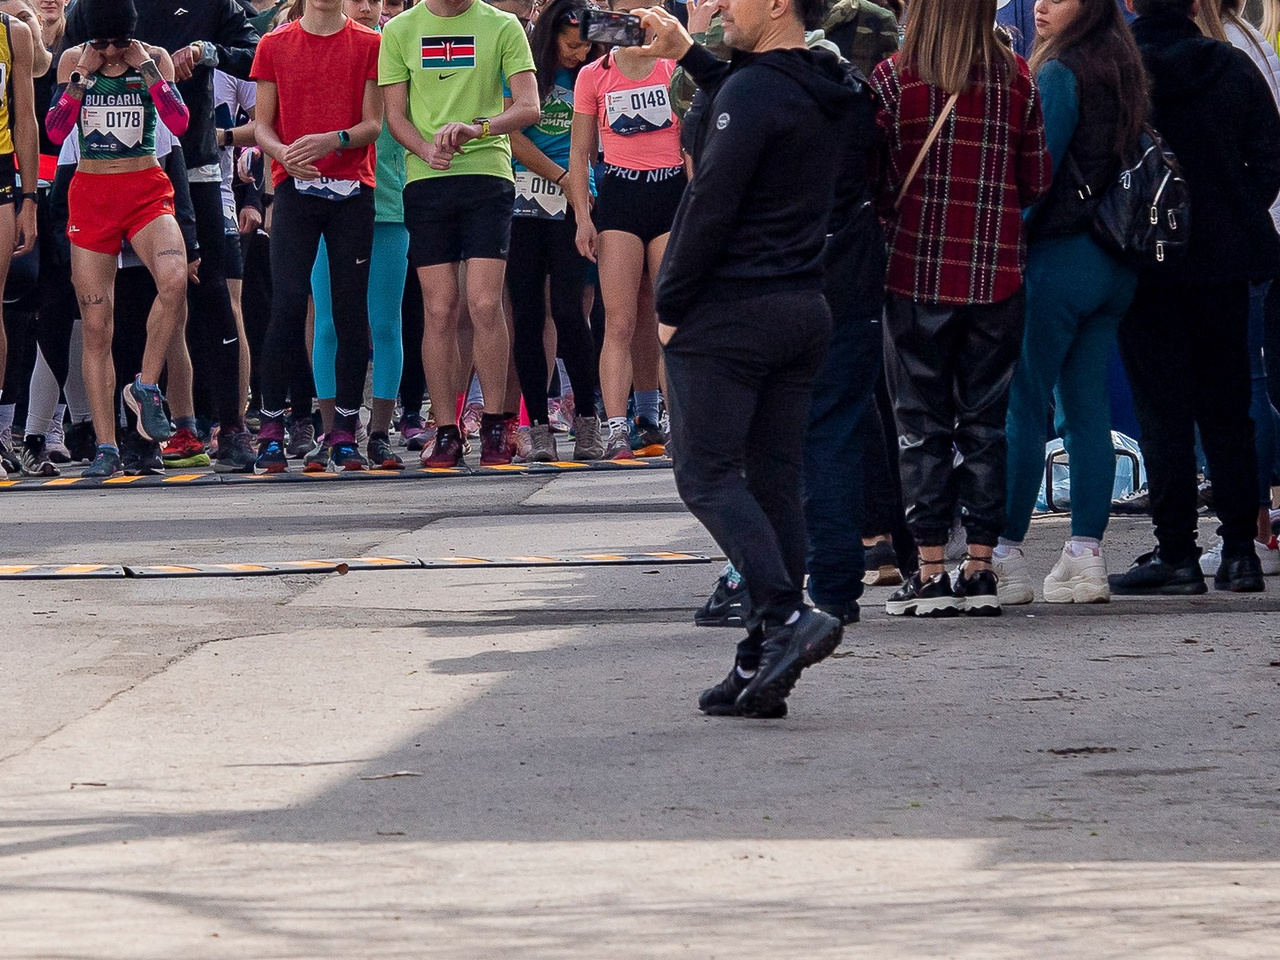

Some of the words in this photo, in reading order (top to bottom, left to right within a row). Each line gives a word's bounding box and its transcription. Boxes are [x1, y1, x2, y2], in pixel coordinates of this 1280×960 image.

[85, 93, 143, 106] BULGARIA
[630, 89, 667, 111] 0148
[106, 111, 141, 128] 0178
